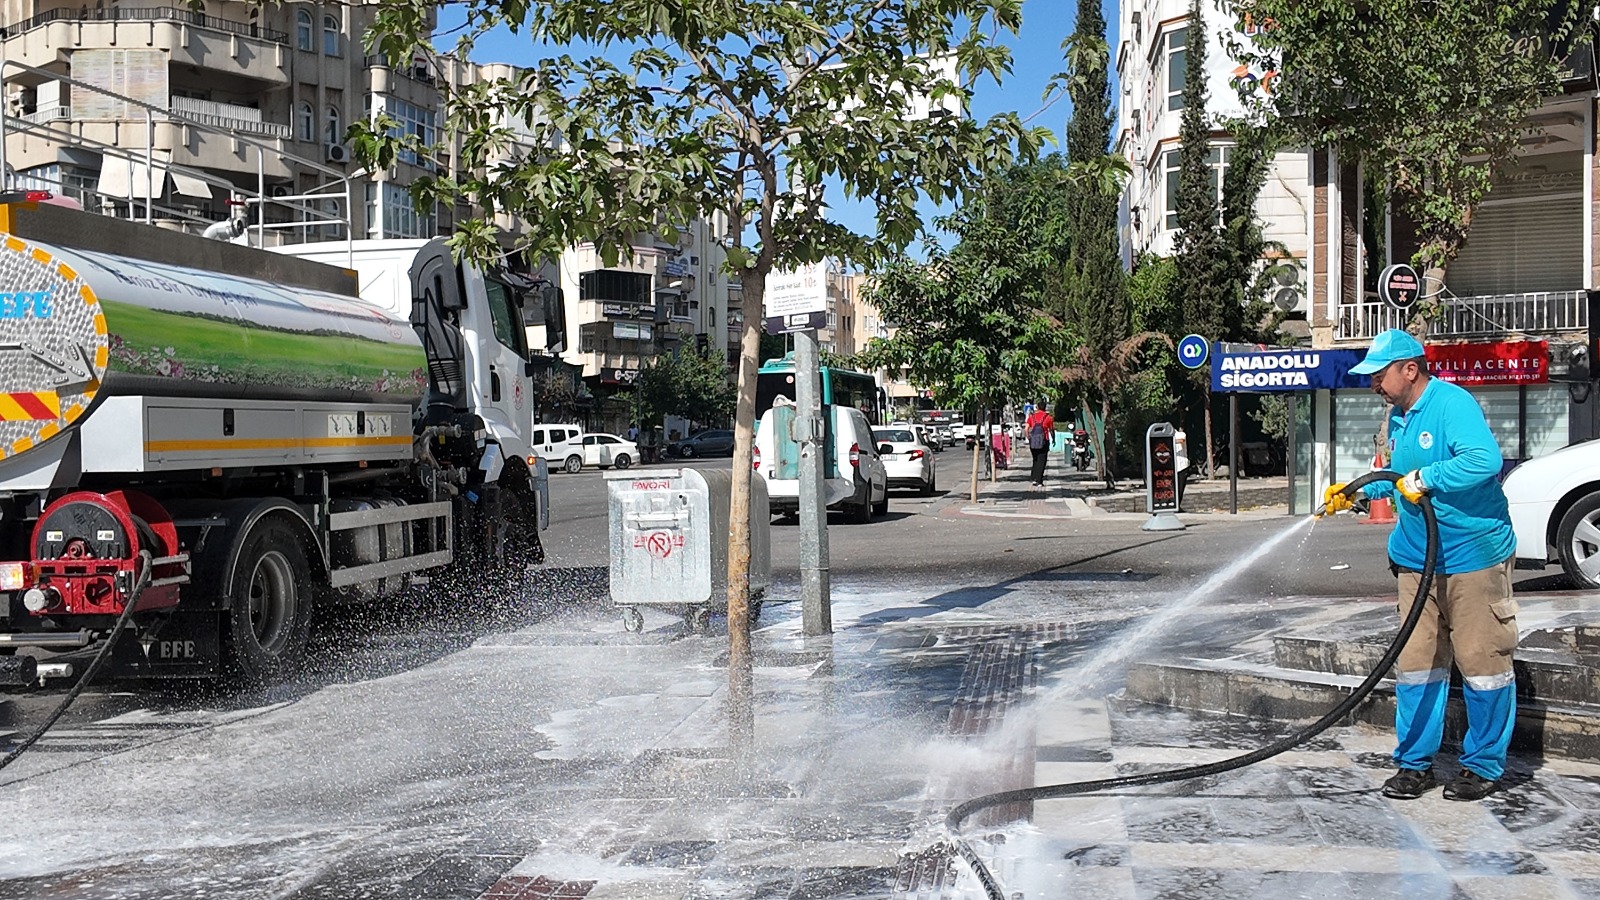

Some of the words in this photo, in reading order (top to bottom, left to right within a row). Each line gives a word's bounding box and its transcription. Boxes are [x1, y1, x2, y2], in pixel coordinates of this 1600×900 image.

[157, 277, 184, 294] Bir
[0, 292, 53, 319] EFE
[1221, 354, 1320, 371] ANADOLU
[1426, 358, 1467, 371] TKİLİ
[1473, 359, 1539, 370] ACENTE
[1220, 370, 1309, 388] SİGORTA
[160, 640, 196, 659] EFE
